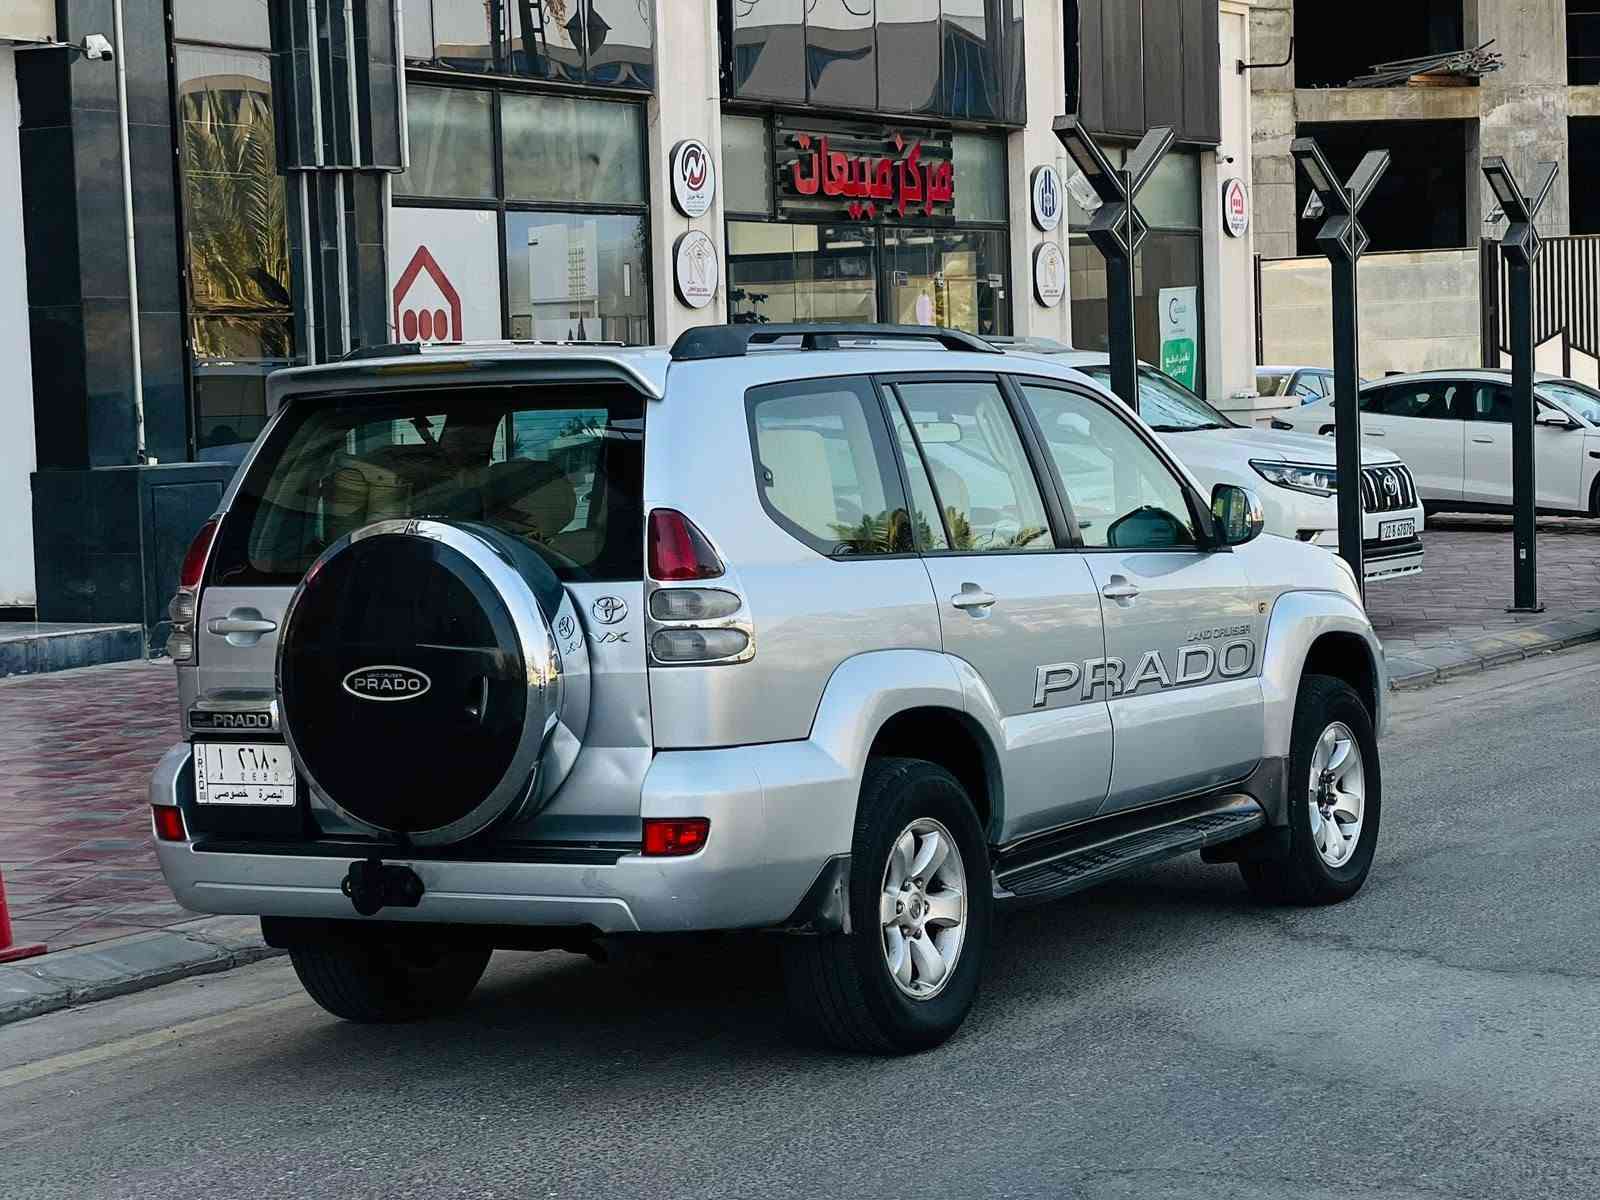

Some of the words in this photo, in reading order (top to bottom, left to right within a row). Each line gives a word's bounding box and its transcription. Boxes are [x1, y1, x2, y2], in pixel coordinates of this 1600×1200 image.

[793, 132, 894, 219] مبيعات
[893, 132, 953, 218] مركز
[354, 678, 420, 690] PRADO
[1032, 638, 1256, 708] PRADO
[212, 713, 269, 728] PRADO
